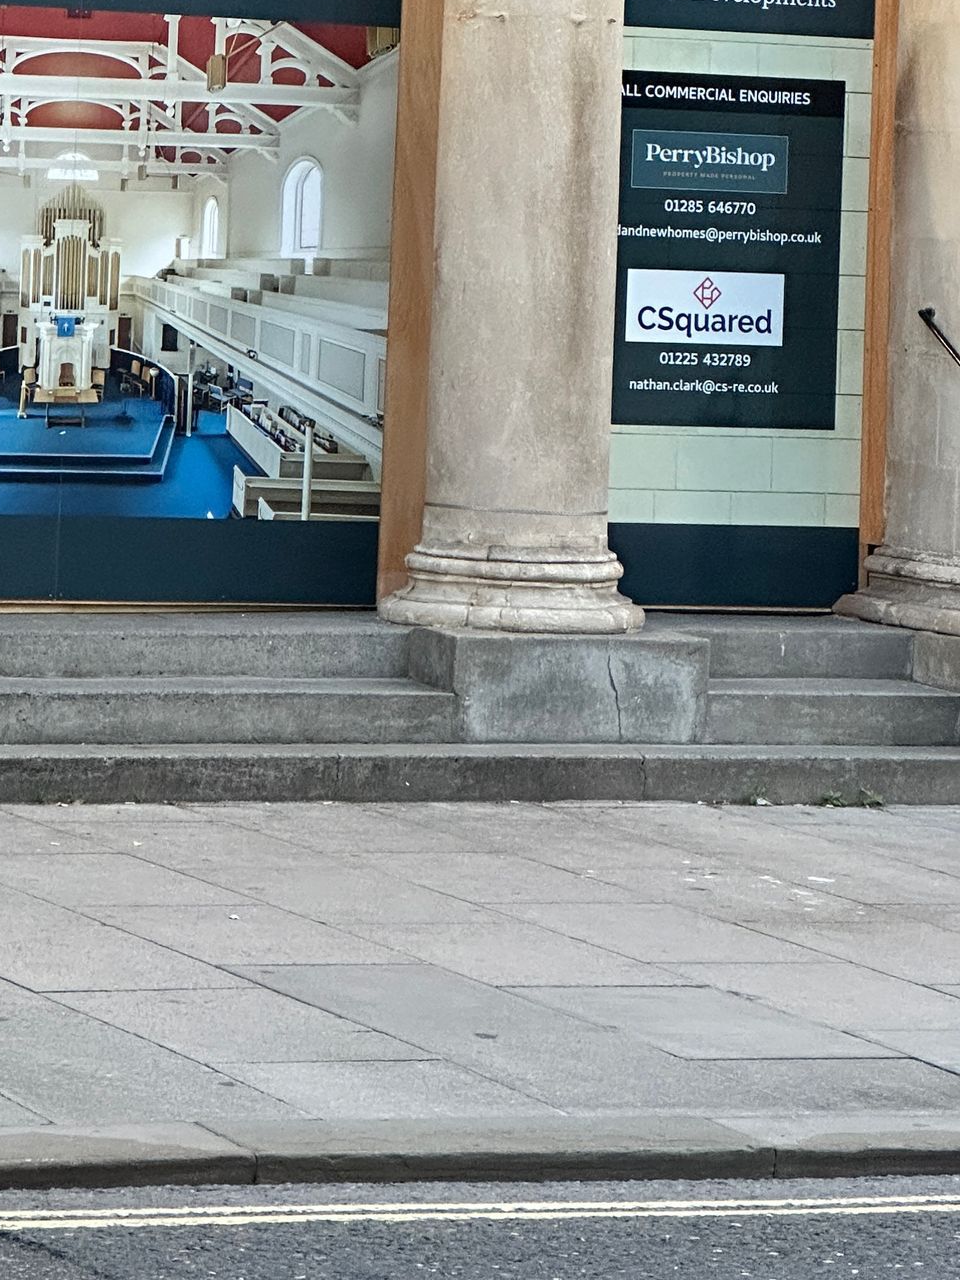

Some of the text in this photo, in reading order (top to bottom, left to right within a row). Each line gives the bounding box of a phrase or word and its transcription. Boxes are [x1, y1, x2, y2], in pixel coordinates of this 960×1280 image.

[644, 84, 736, 102] COMMERCIAL
[739, 89, 811, 105] ENQUIRIES
[645, 143, 776, 172] PerryBishop
[664, 198, 757, 215] 01285 646770
[637, 305, 772, 338] CSquared
[659, 351, 751, 367] 01225 432789
[629, 377, 779, 395] nathan.clark@cs-re.co.uk
